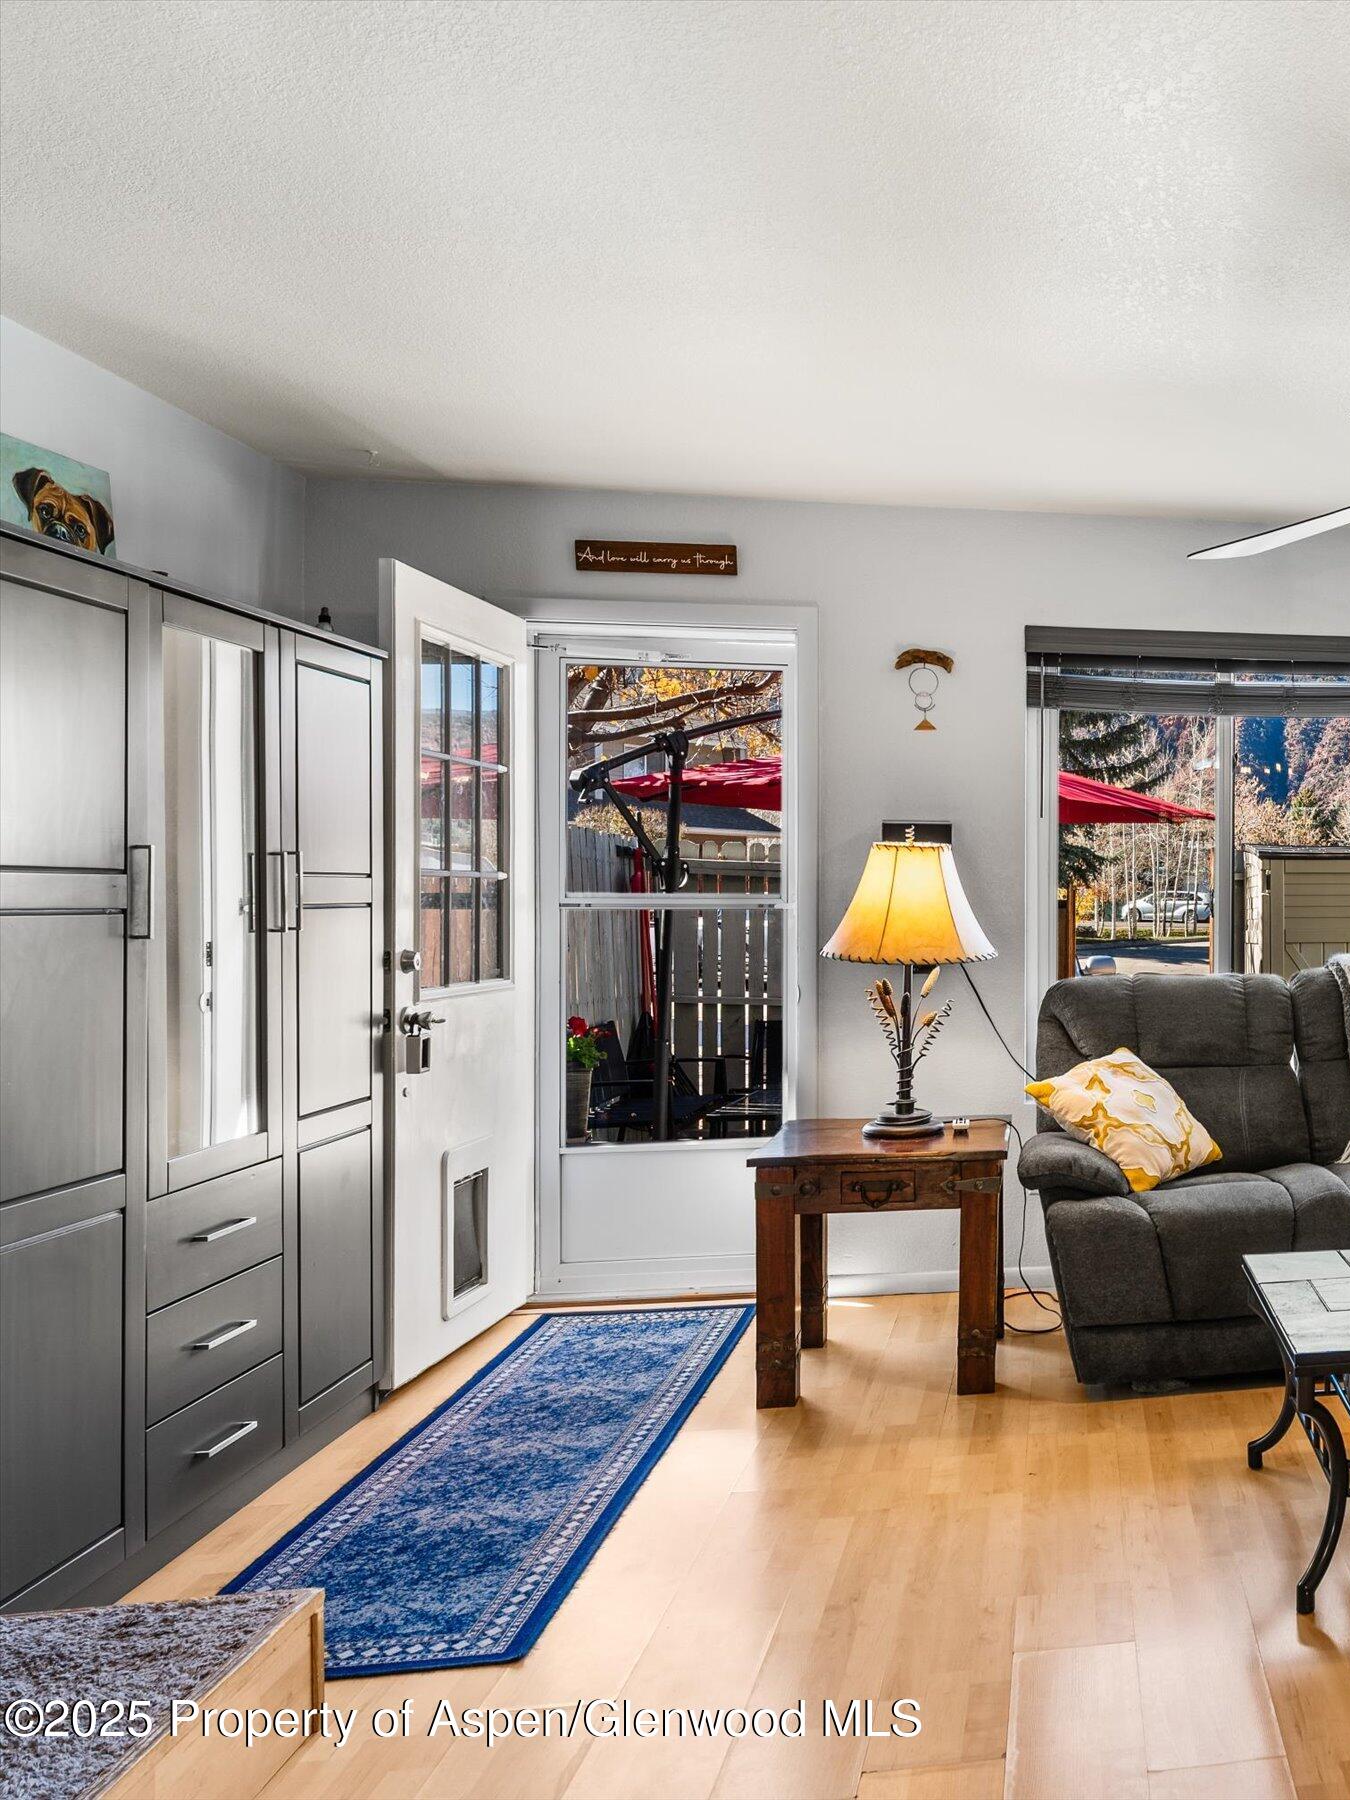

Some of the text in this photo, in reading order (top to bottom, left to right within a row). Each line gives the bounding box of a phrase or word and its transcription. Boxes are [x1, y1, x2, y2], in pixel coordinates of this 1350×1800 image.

[577, 546, 605, 564] And
[607, 550, 627, 562] love
[629, 551, 649, 563] will
[652, 557, 678, 569] carry
[693, 552, 734, 570] through
